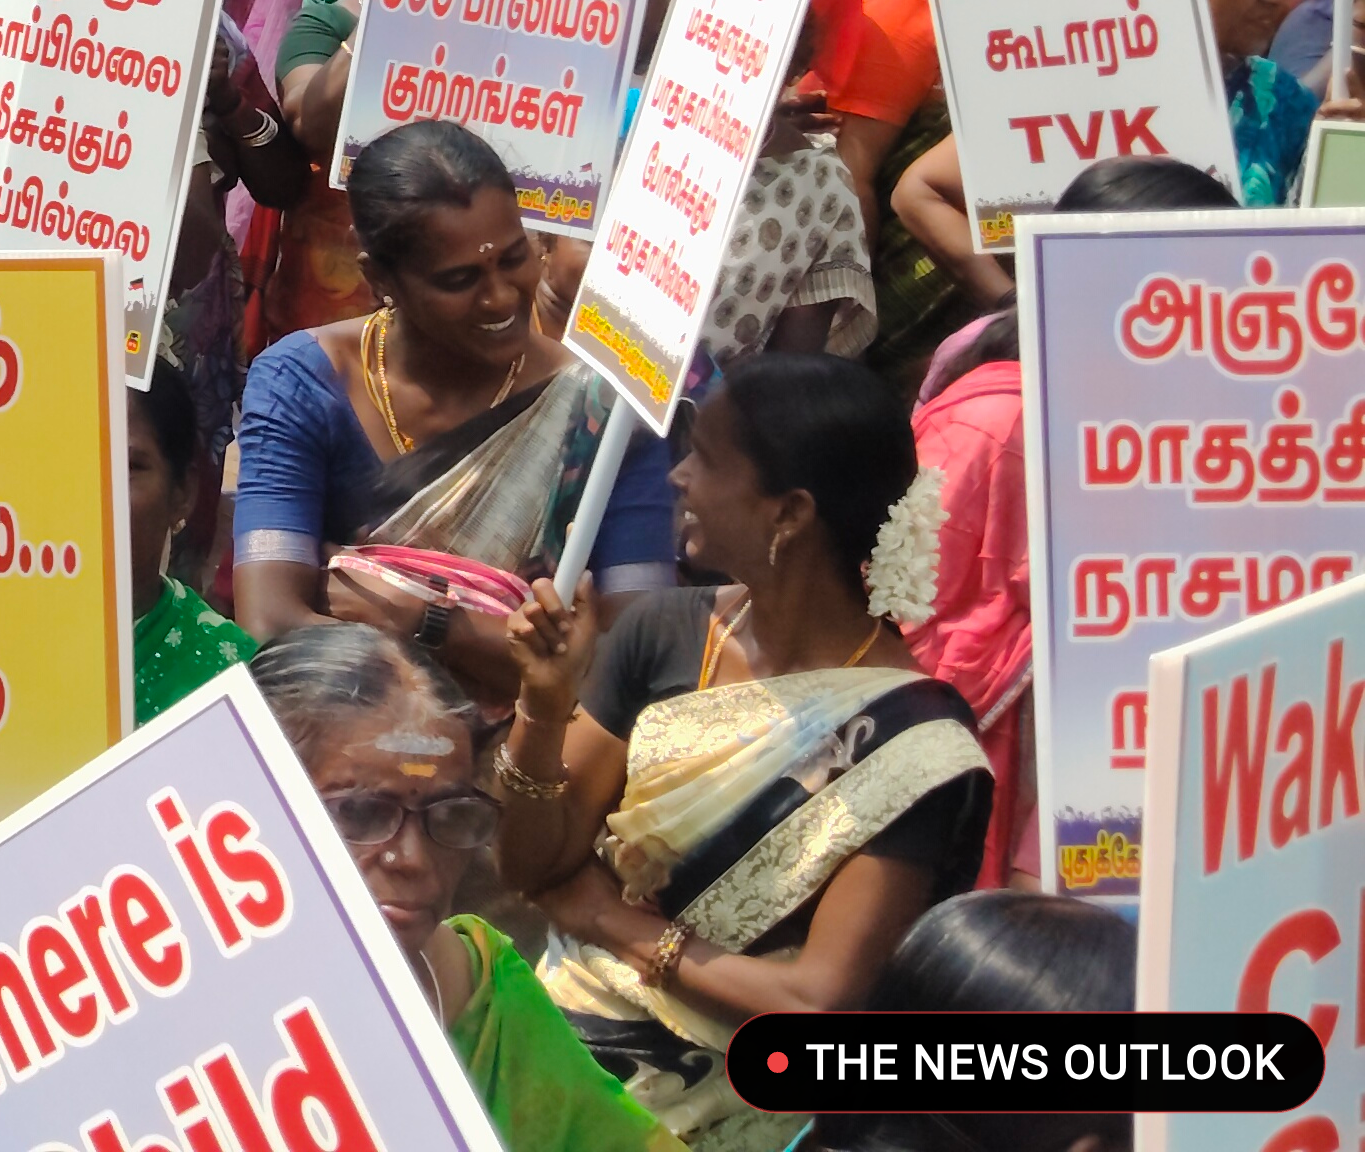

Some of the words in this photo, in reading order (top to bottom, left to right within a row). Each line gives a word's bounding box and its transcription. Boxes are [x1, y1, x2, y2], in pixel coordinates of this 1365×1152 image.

[382, 42, 585, 139] குற்றங்கள்
[1008, 105, 1169, 165] TVK
[156, 796, 287, 950] is
